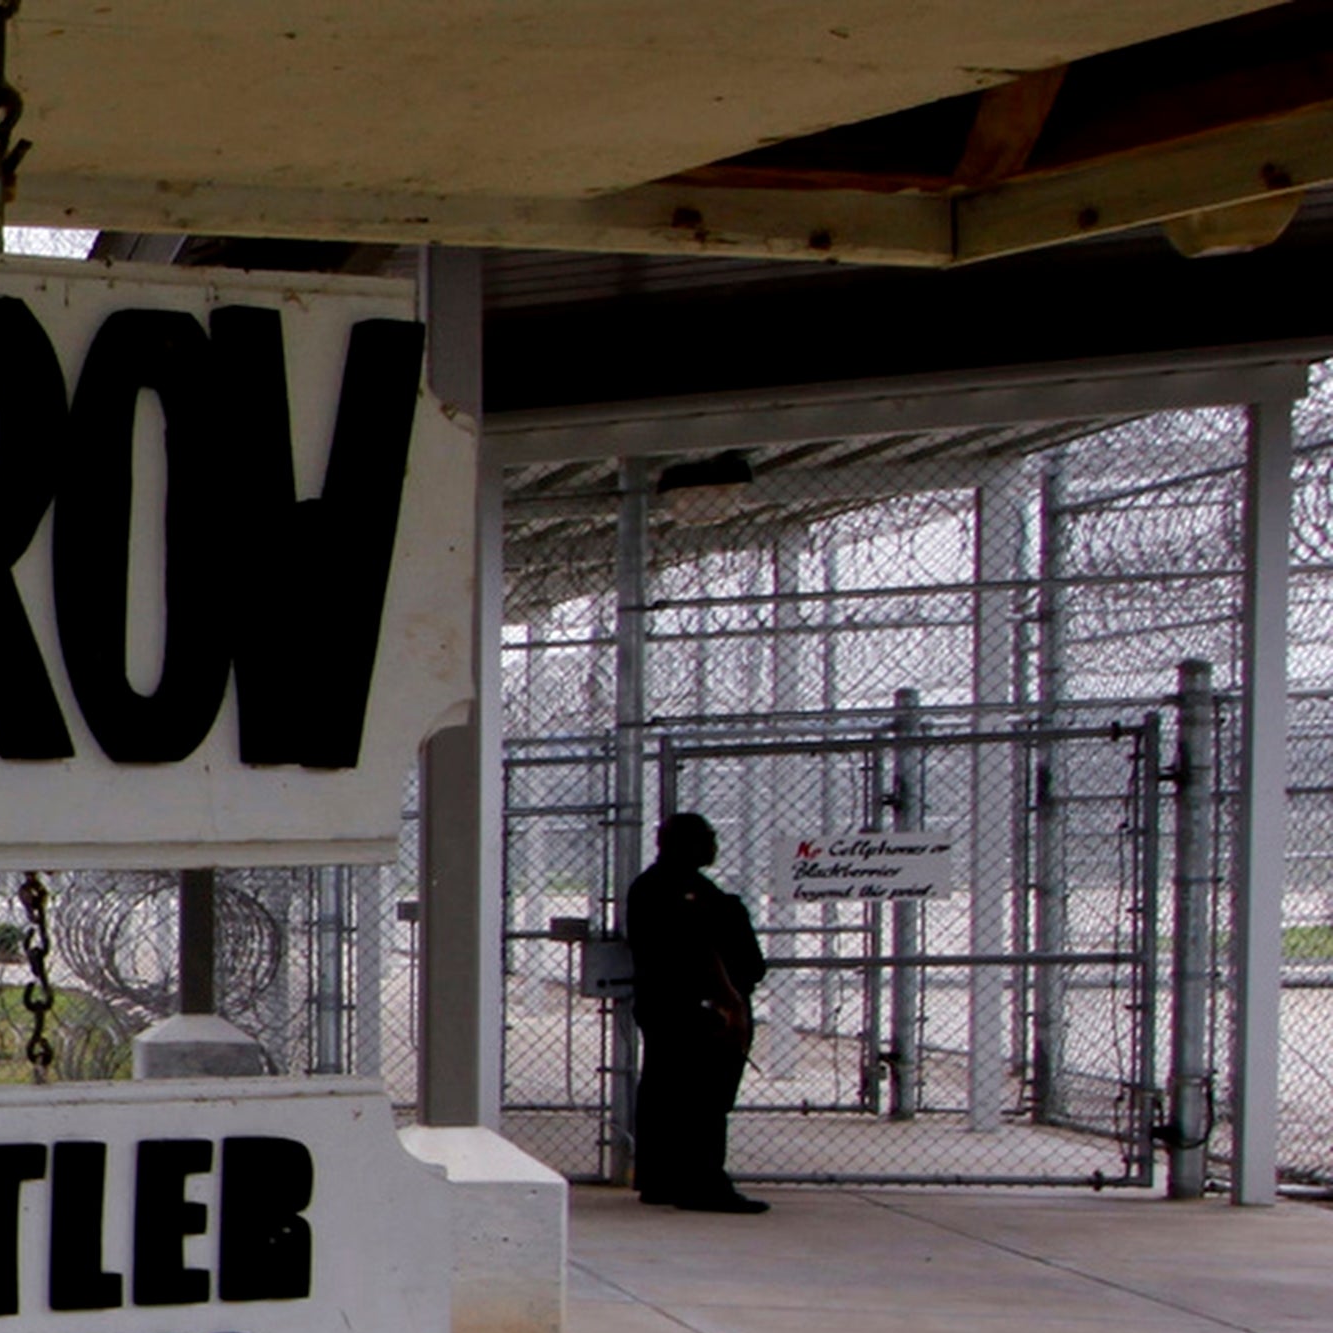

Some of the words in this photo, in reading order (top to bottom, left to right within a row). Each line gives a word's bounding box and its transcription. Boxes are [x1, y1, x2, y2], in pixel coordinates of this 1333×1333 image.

[794, 840, 821, 859] No
[827, 838, 926, 861] Cellphones
[791, 884, 854, 902] beyond
[859, 882, 887, 898] this
